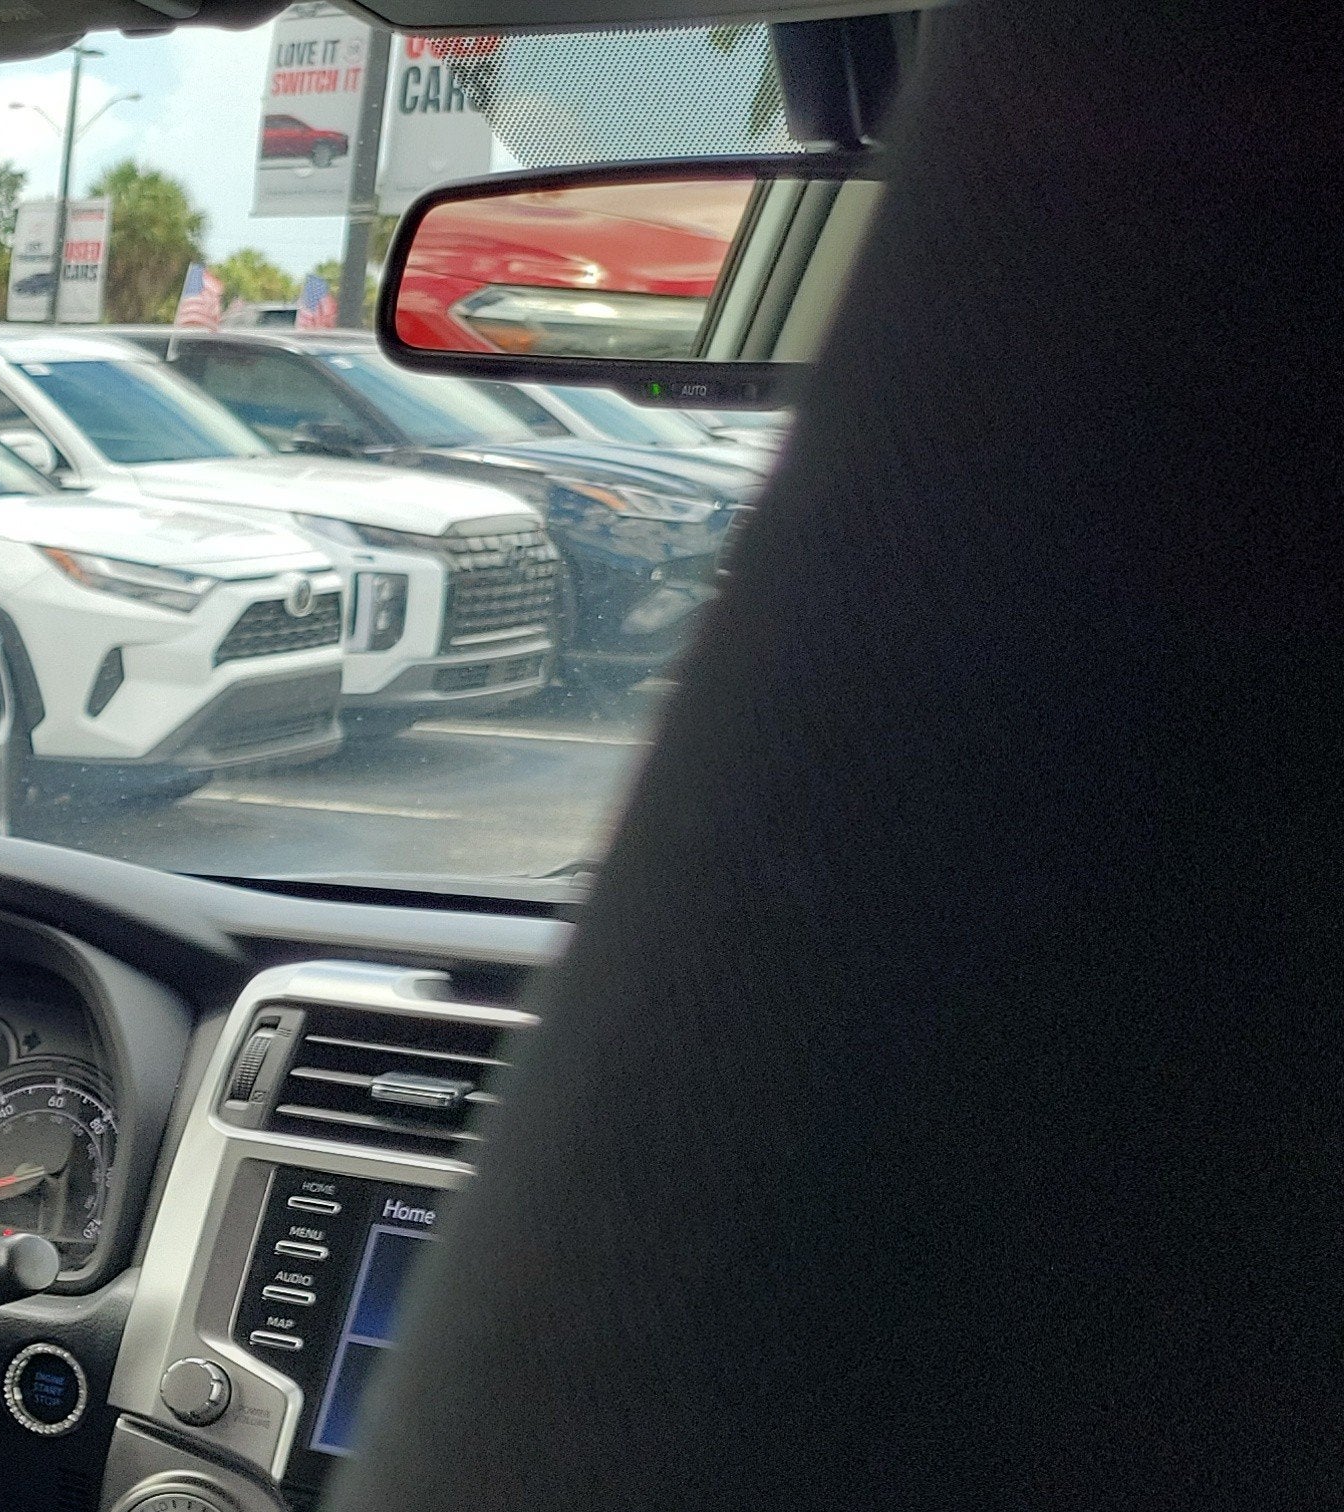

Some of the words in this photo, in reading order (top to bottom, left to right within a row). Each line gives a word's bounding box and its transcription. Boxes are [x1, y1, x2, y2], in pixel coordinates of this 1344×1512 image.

[276, 41, 316, 68] LOVE
[322, 40, 340, 65] IT
[271, 69, 339, 96] SWITCH
[344, 67, 362, 93] IT
[65, 240, 103, 263] USED
[63, 264, 99, 281] CARS
[681, 384, 708, 397] AUTO
[48, 1096, 65, 1109] 60
[89, 1117, 106, 1135] 80
[302, 1181, 336, 1195] HOME
[382, 1199, 437, 1225] Home
[288, 1225, 324, 1241] MENU
[275, 1270, 313, 1286] AUDIO
[266, 1316, 295, 1330] MAP
[34, 1382, 64, 1395] START
